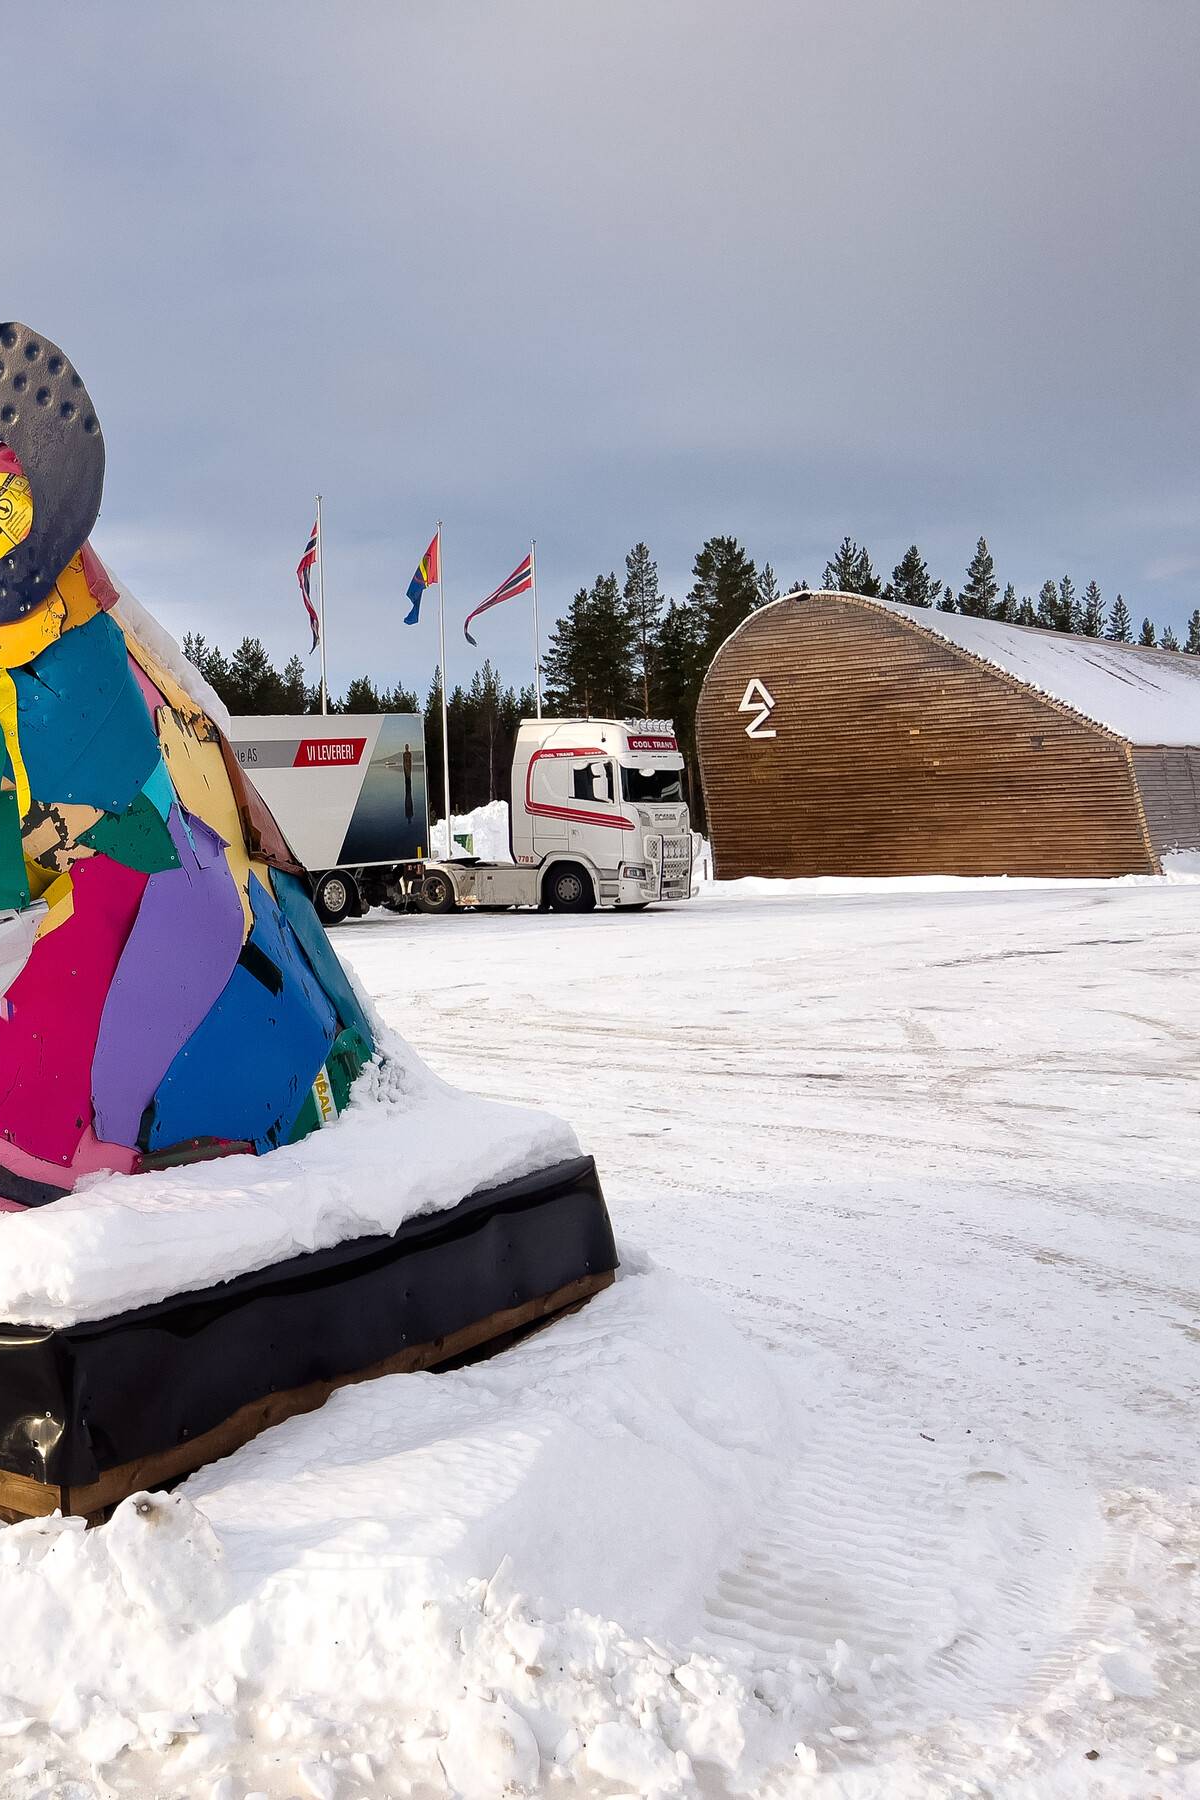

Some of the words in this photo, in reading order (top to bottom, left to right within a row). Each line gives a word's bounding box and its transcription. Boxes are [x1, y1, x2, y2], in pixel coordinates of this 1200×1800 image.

[653, 741, 674, 749] TRANS
[247, 748, 258, 762] AS
[306, 745, 316, 761] VI
[317, 744, 355, 761] LEVERER!
[518, 855, 530, 863] 770
